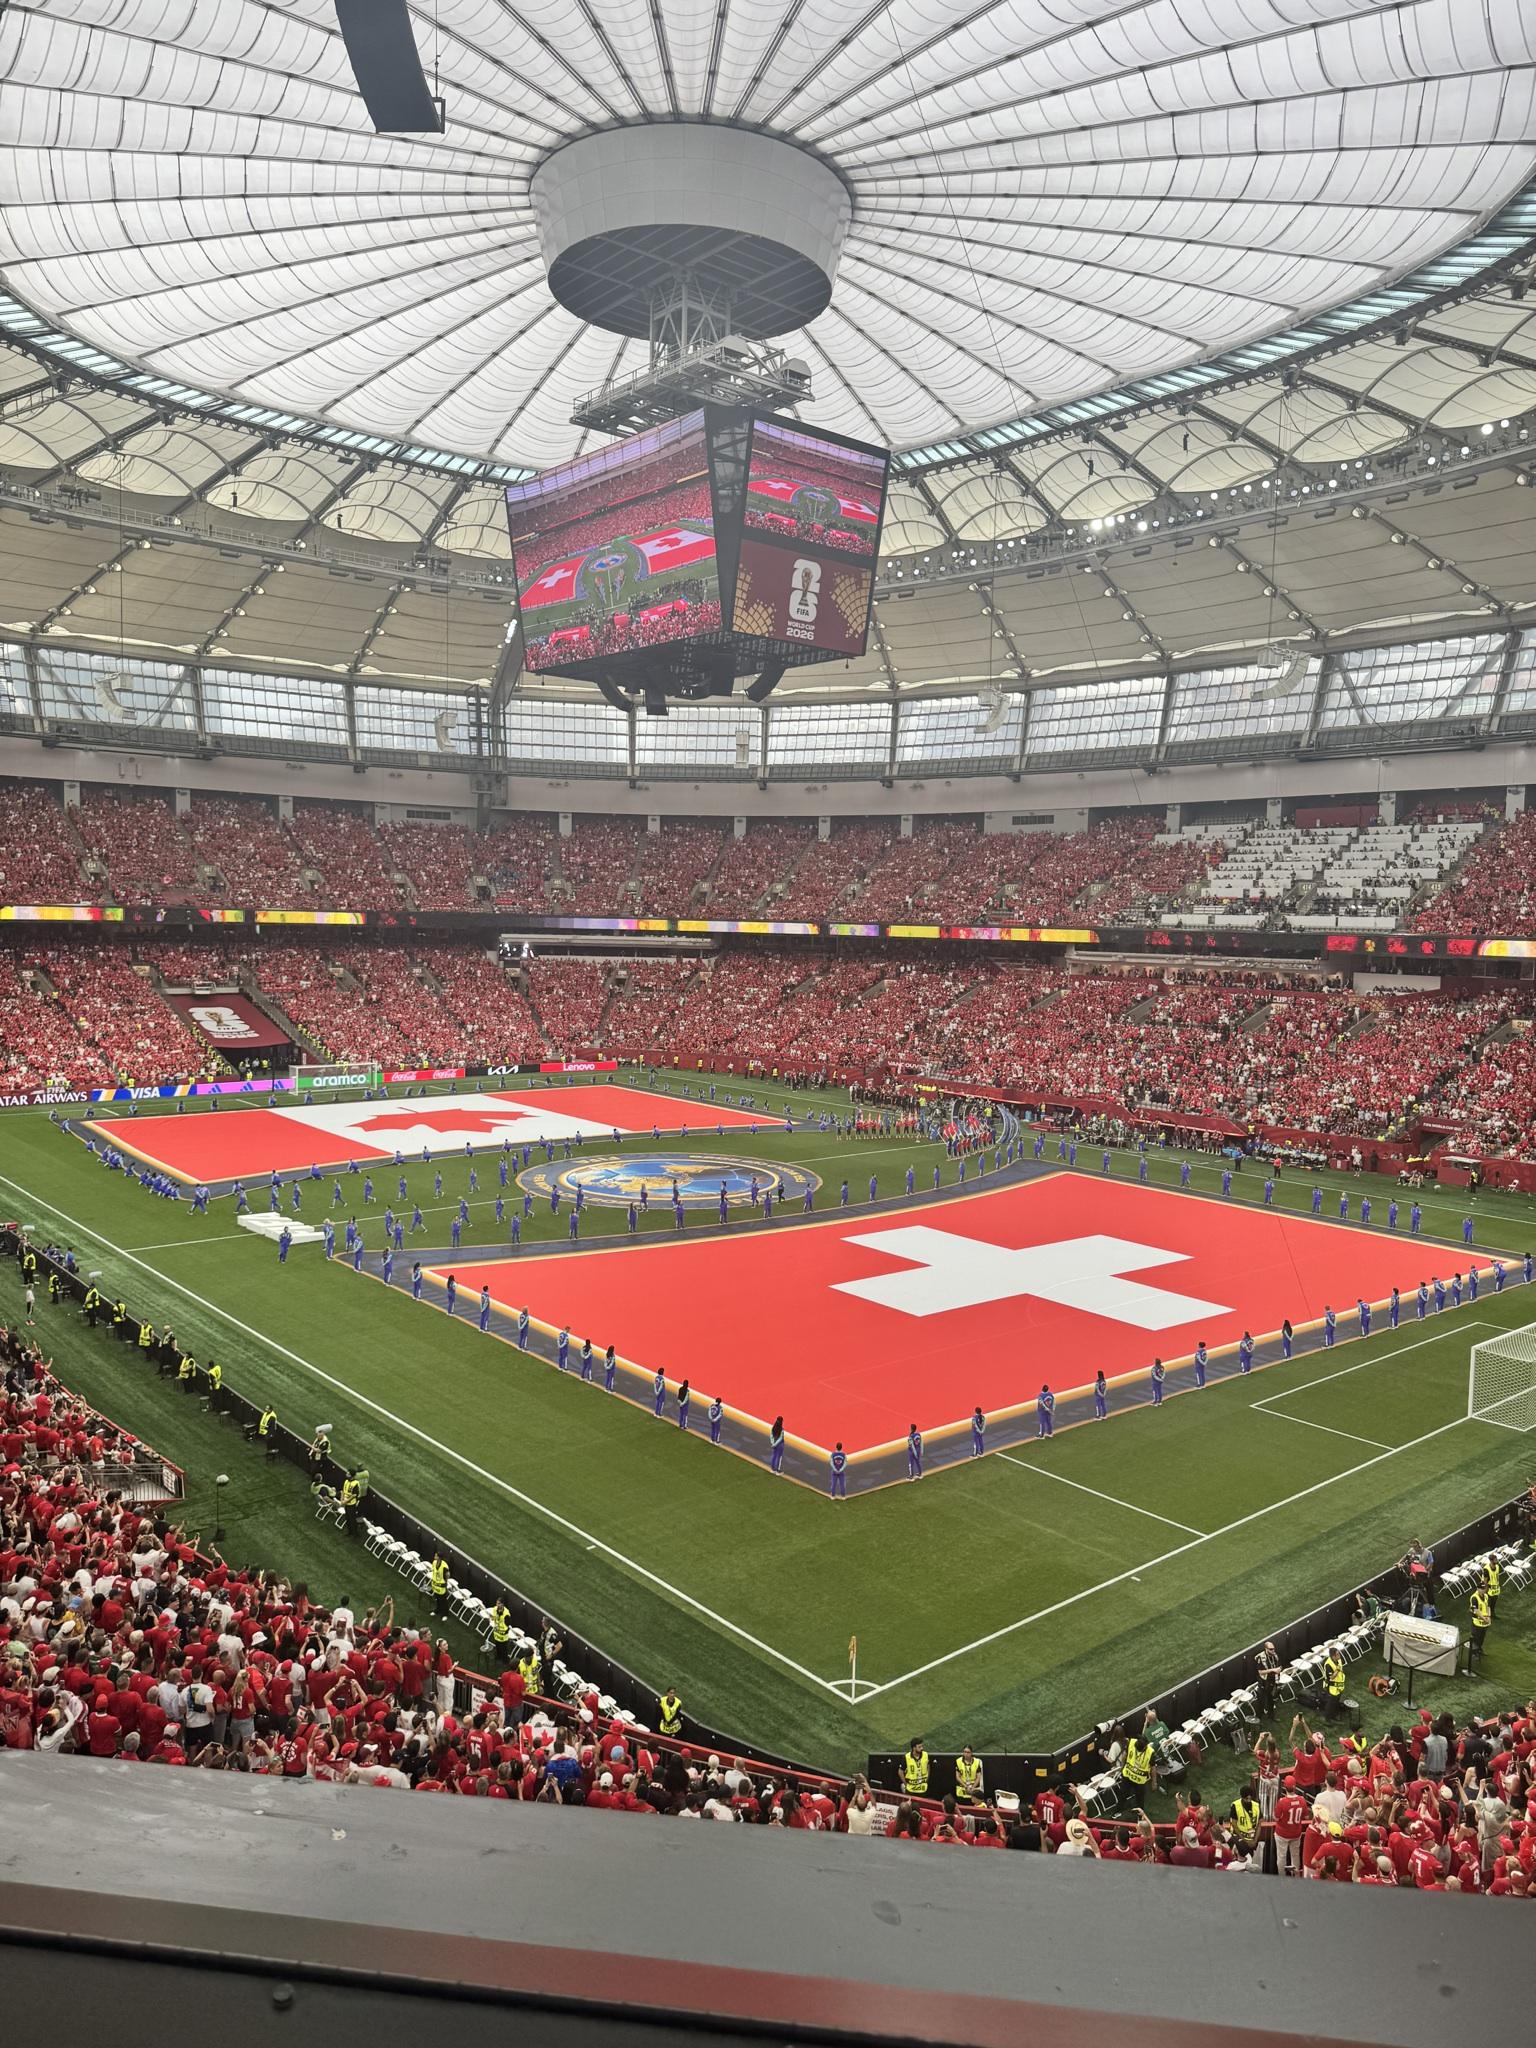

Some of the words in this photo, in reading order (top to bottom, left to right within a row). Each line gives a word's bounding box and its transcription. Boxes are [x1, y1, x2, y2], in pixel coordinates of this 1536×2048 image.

[796, 608, 810, 617] FIFA
[787, 620, 805, 630] WORLD
[786, 627, 815, 640] 2026
[487, 1065, 519, 1075] KIA
[563, 1063, 595, 1071] Lenovo
[313, 1074, 366, 1087] aramco
[33, 1091, 88, 1105] AIRWAYS
[129, 1086, 160, 1099] VISA
[1043, 1806, 1054, 1824] 10
[1287, 1807, 1303, 1824] 10
